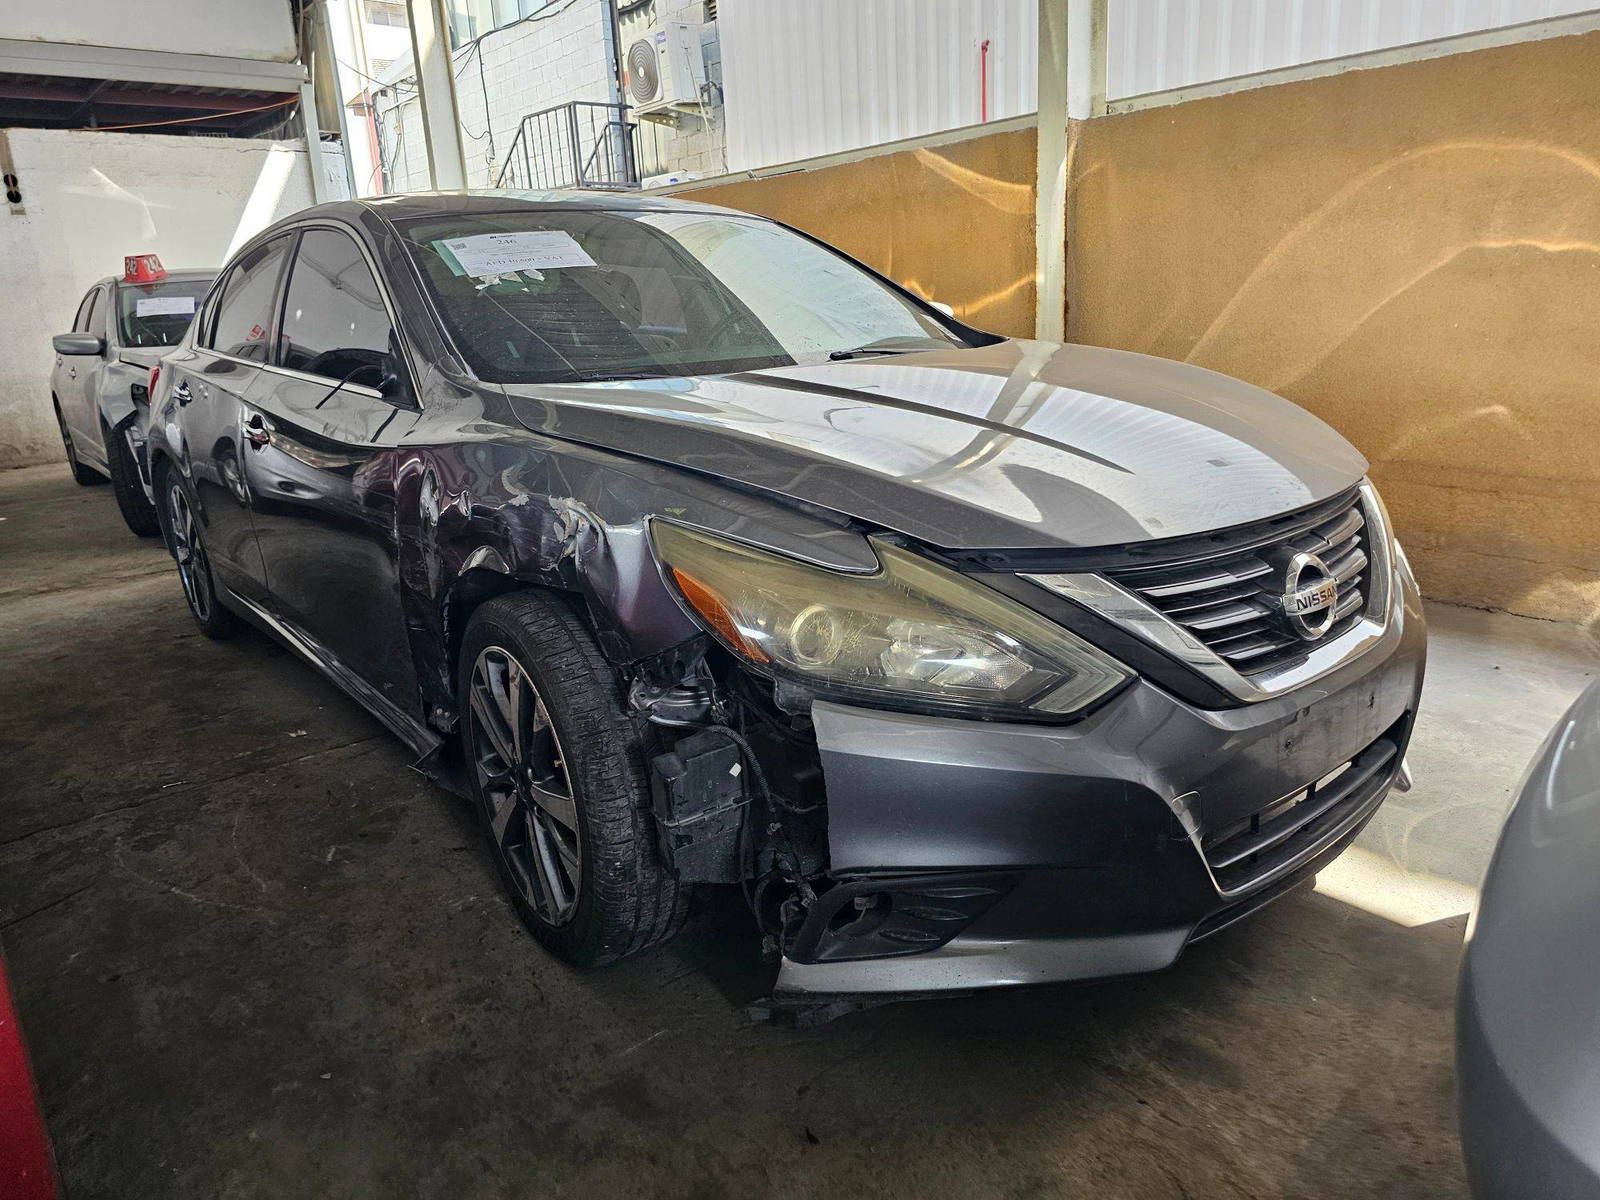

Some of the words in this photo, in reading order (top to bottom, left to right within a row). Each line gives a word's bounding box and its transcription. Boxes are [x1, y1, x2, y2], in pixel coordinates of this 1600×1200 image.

[126, 258, 138, 275] 242
[144, 256, 163, 274] 242
[1296, 586, 1337, 611] NISSAN
